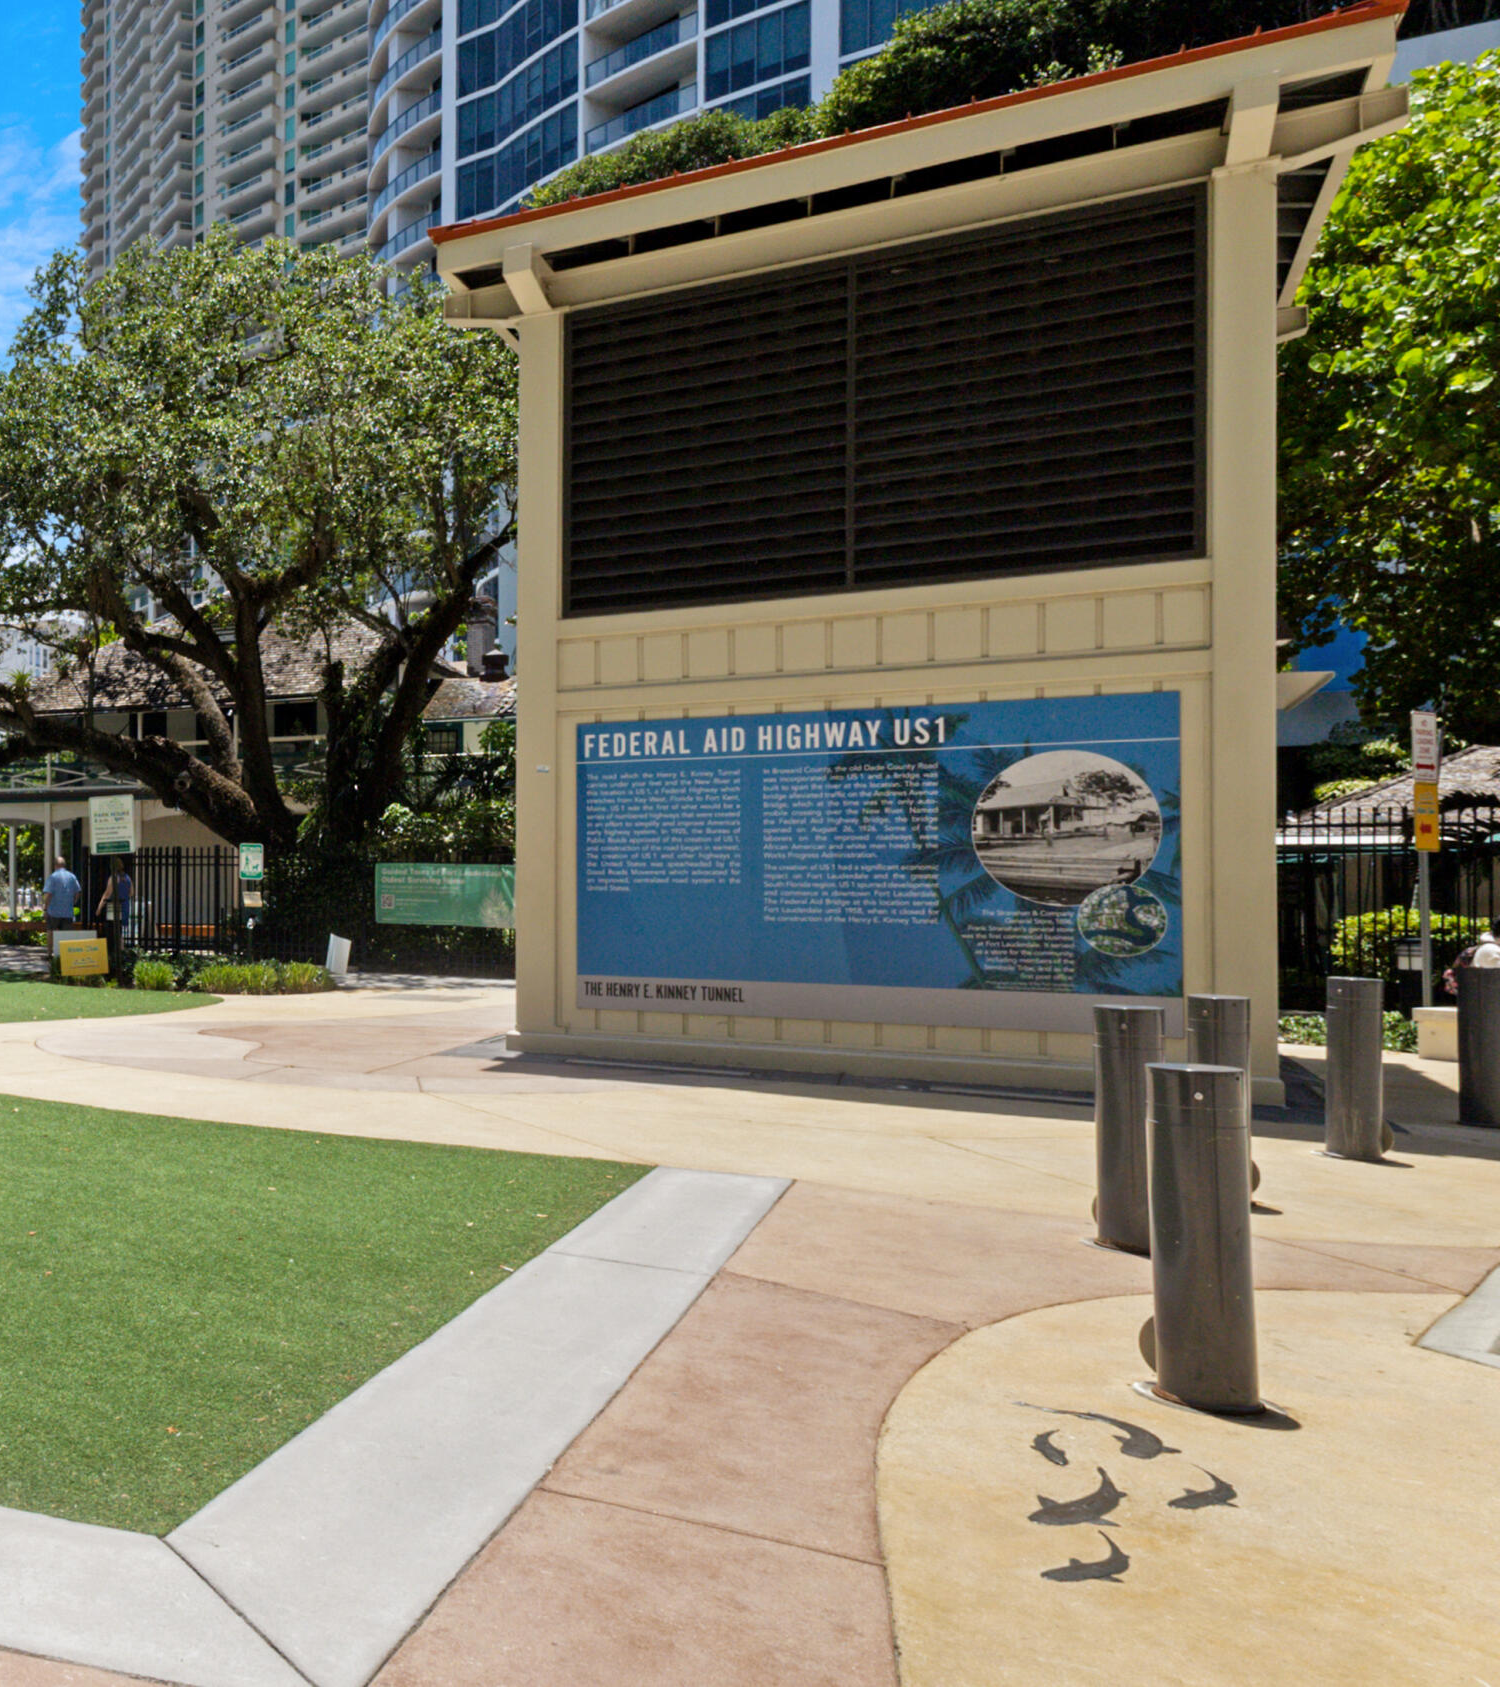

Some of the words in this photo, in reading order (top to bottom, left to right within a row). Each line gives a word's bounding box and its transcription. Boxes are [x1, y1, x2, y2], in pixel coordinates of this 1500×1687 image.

[584, 729, 691, 758] FEDERAL
[703, 726, 746, 753] AID
[758, 720, 882, 751] HIGHWAY
[893, 716, 946, 746] US1
[584, 981, 603, 997] THE
[606, 982, 640, 998] HENRY
[643, 984, 653, 999] E.
[656, 984, 697, 1001] KINNEY
[701, 986, 744, 1003] TUNNEL
